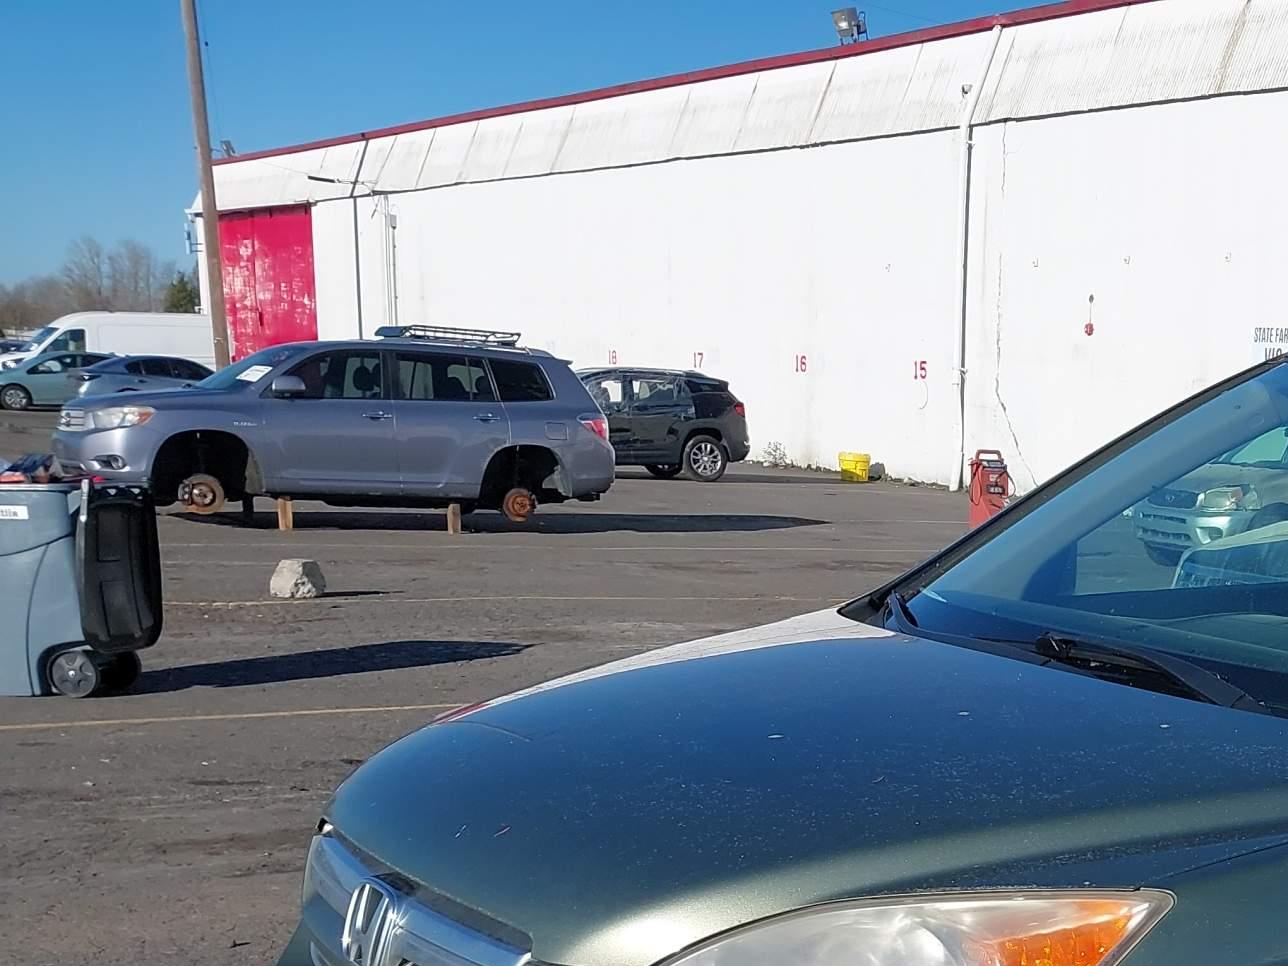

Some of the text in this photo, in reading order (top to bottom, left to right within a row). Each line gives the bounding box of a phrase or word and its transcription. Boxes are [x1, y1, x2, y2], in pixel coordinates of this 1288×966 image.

[1254, 327, 1273, 343] STATE
[608, 350, 617, 365] 18
[693, 352, 704, 368] 17
[795, 354, 807, 372] 16
[914, 360, 927, 380] 15
